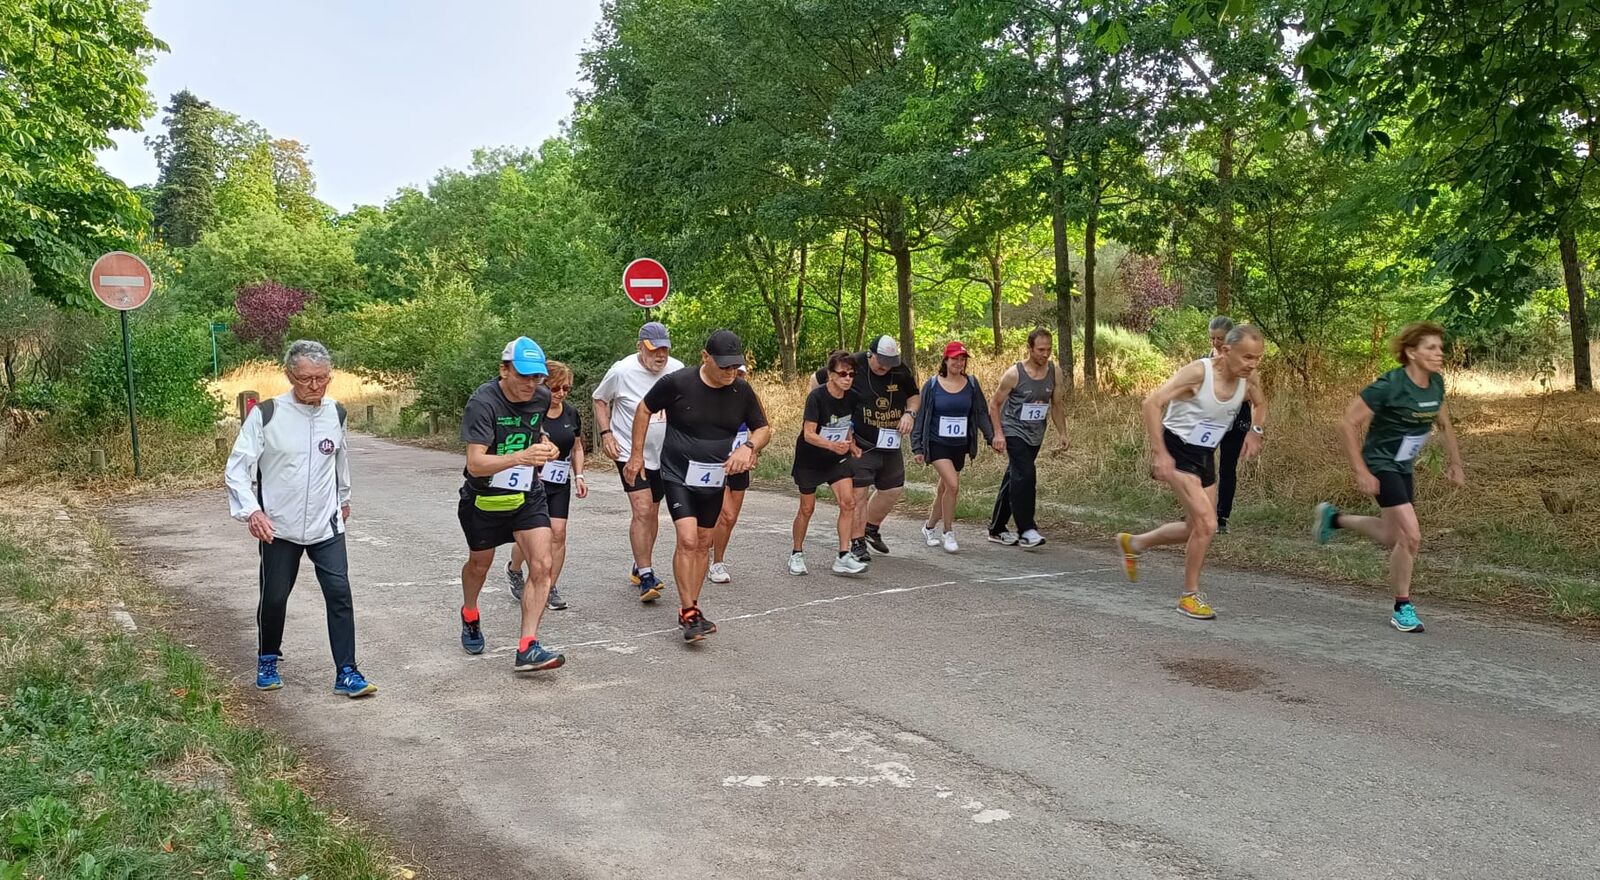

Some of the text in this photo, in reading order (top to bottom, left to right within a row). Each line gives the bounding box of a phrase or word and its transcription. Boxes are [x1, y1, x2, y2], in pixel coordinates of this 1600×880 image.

[863, 407, 872, 418] la
[1028, 409, 1042, 420] 13
[946, 424, 961, 435] 10
[887, 436, 894, 447] 9
[1200, 431, 1212, 443] 6
[508, 472, 520, 488] 5
[550, 469, 565, 482] 15
[700, 472, 711, 484] 4
